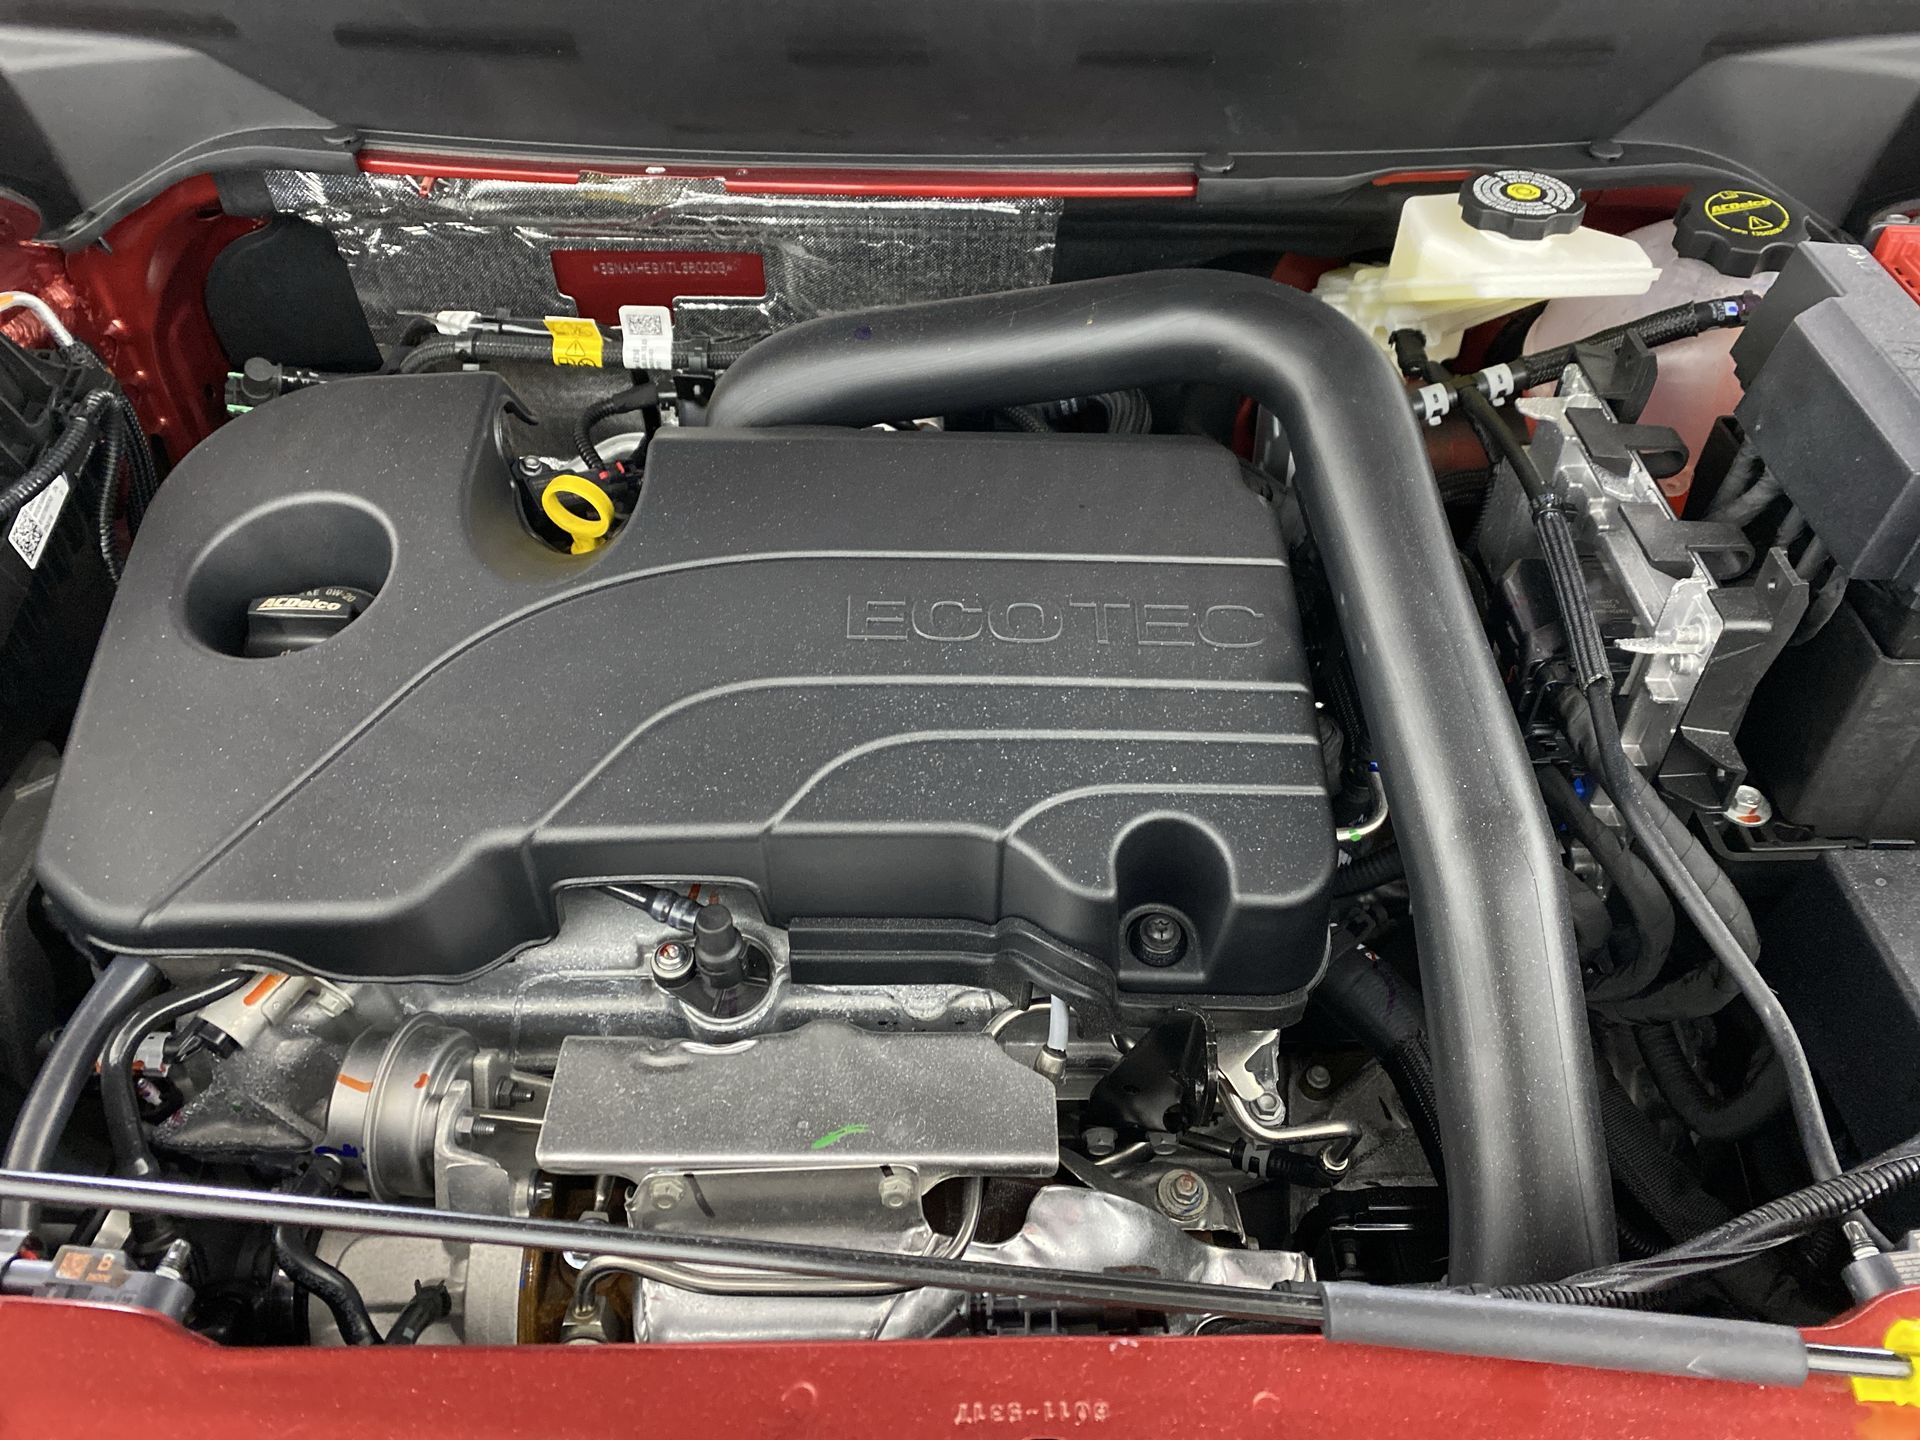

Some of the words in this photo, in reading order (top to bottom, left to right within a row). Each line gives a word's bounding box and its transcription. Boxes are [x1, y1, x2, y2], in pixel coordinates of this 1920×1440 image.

[1712, 199, 1772, 214] ACDelco
[301, 588, 320, 597] AE
[325, 588, 357, 603] 0W-20
[257, 597, 342, 611] ACDelco
[847, 596, 1266, 648] ECOTEC
